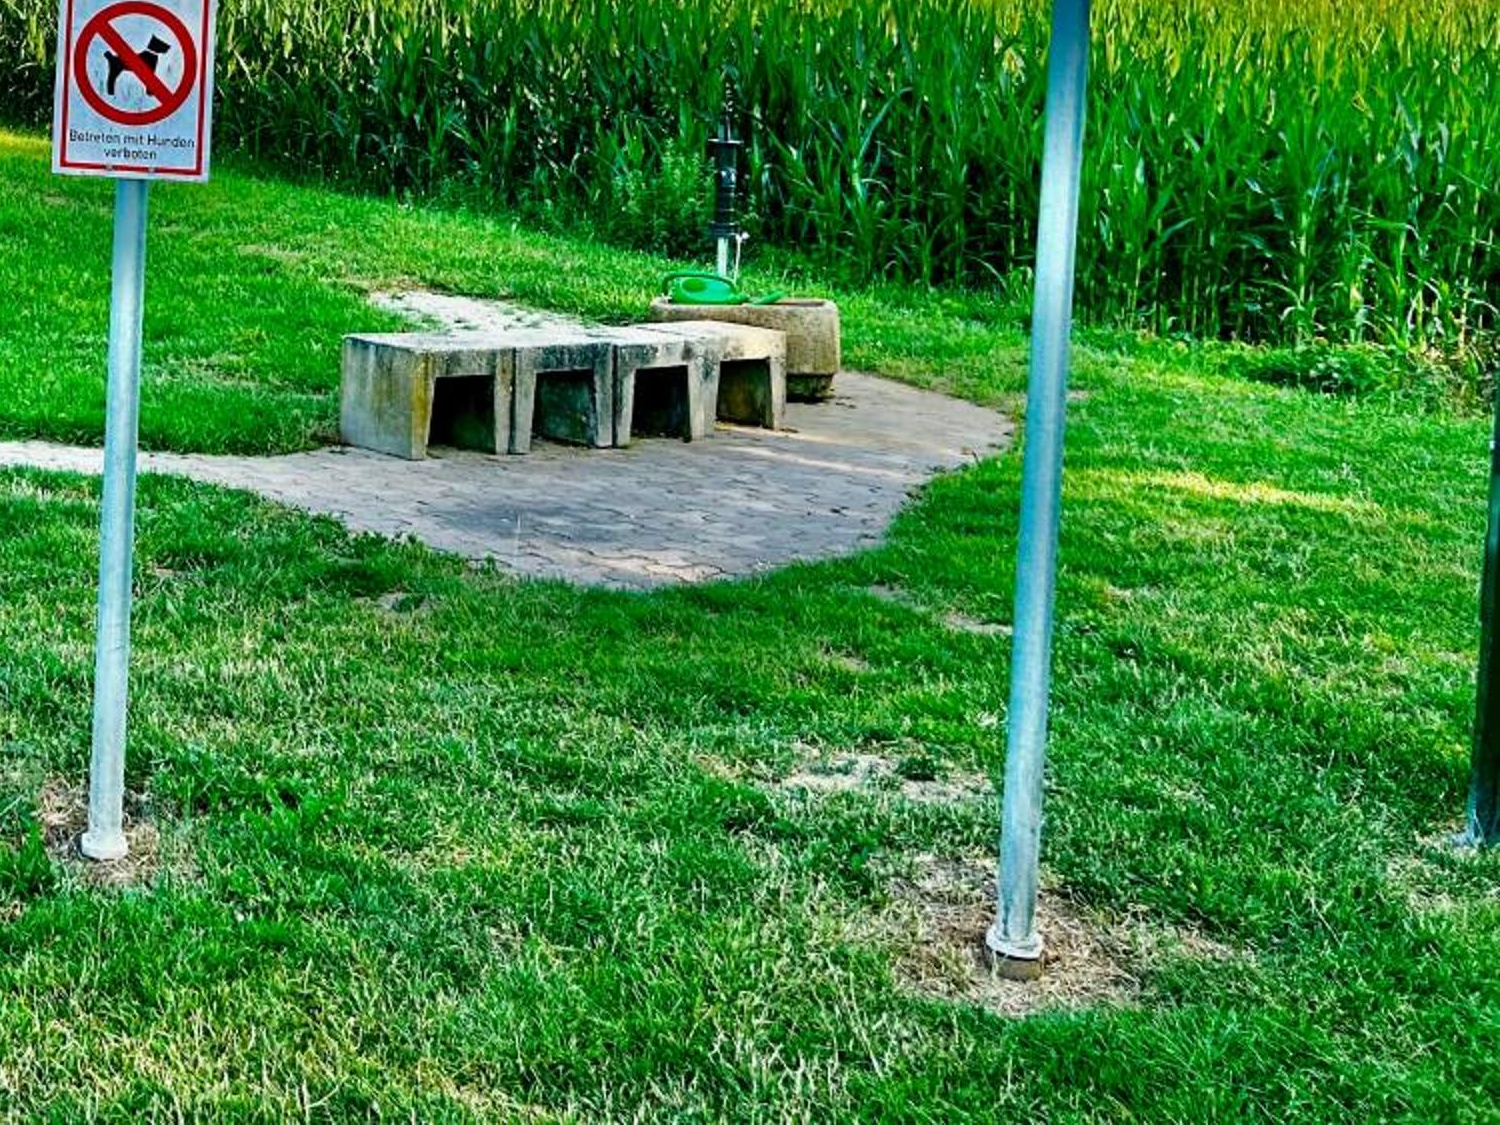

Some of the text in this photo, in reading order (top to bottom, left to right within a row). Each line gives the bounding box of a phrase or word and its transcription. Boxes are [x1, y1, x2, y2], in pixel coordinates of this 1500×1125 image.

[69, 128, 196, 149] Betreten mit Hunden
[103, 146, 157, 161] verboten
